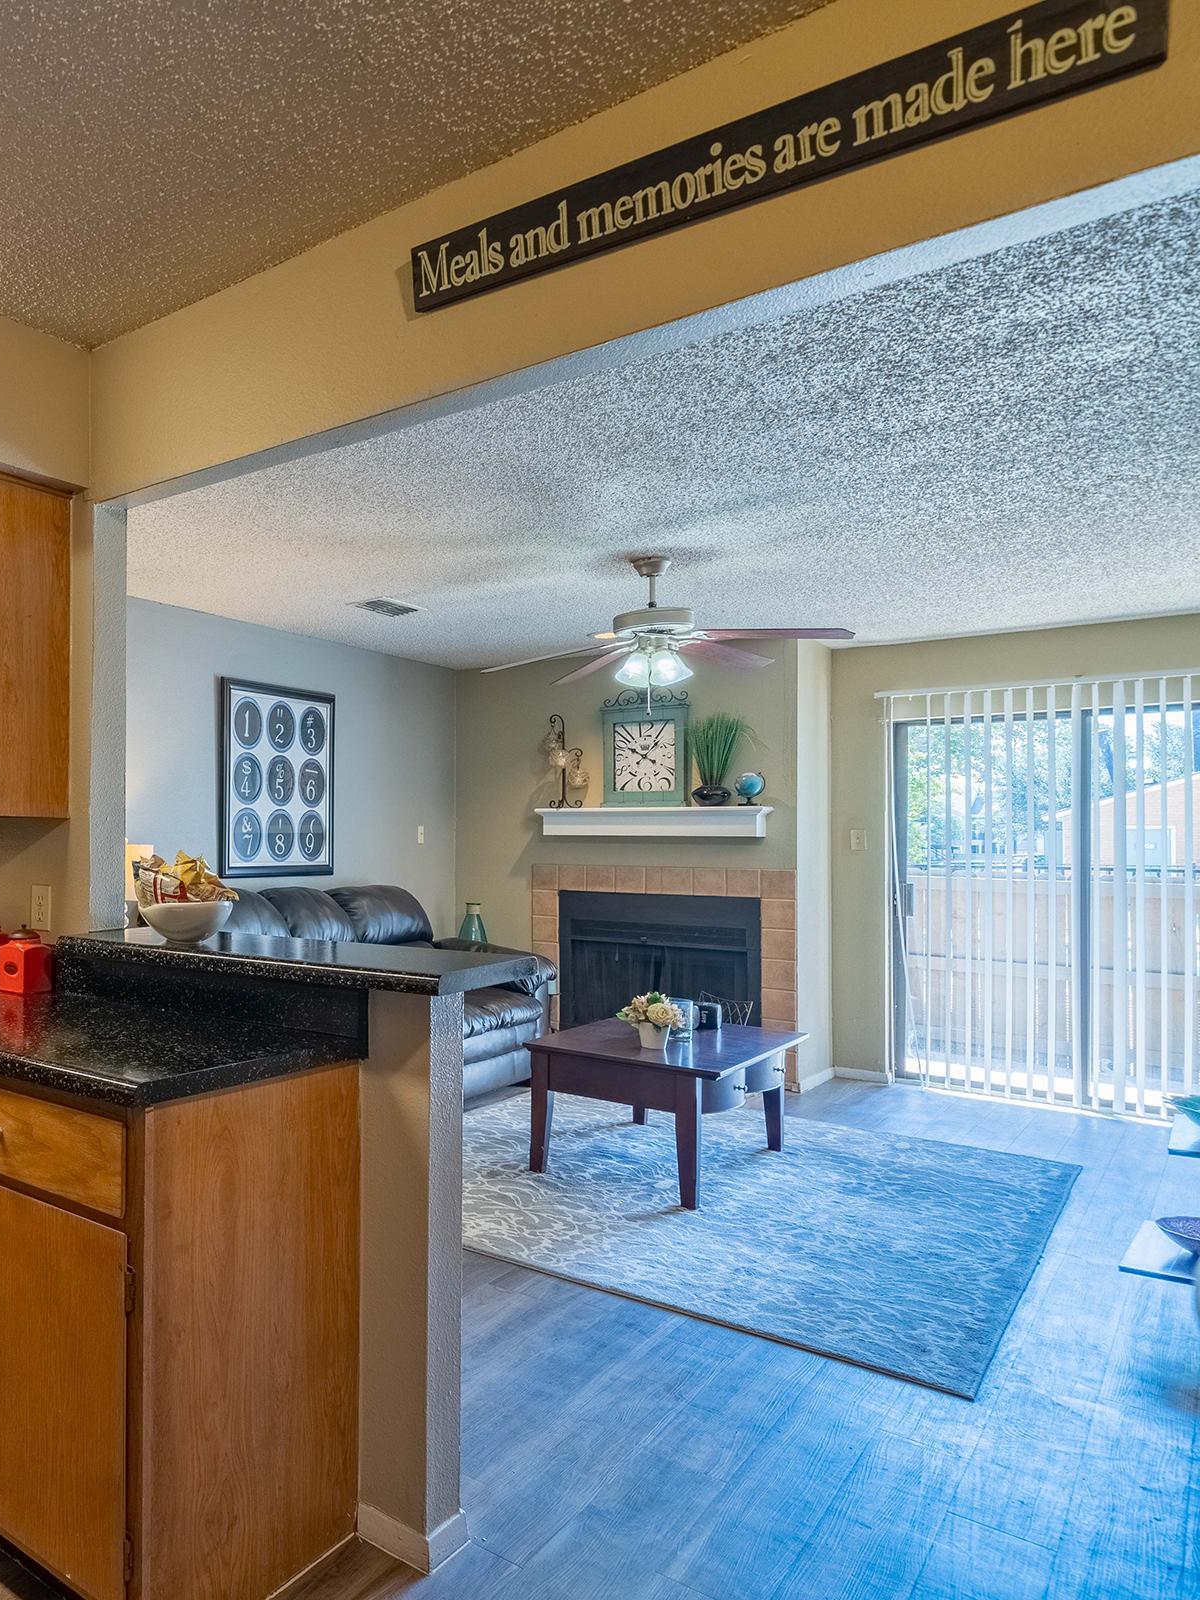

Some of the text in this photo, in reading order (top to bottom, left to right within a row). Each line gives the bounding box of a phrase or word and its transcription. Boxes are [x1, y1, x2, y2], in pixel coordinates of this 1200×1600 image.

[418, 5, 1138, 297] Meals and memories are made here
[244, 710, 249, 738] 1
[275, 723, 284, 743] 2
[307, 728, 316, 748] 3
[241, 776, 251, 797] 4
[275, 778, 284, 800] 5
[307, 779, 316, 801] 6
[242, 833, 253, 856] 7
[275, 833, 285, 855] 8
[305, 833, 314, 854] 9
